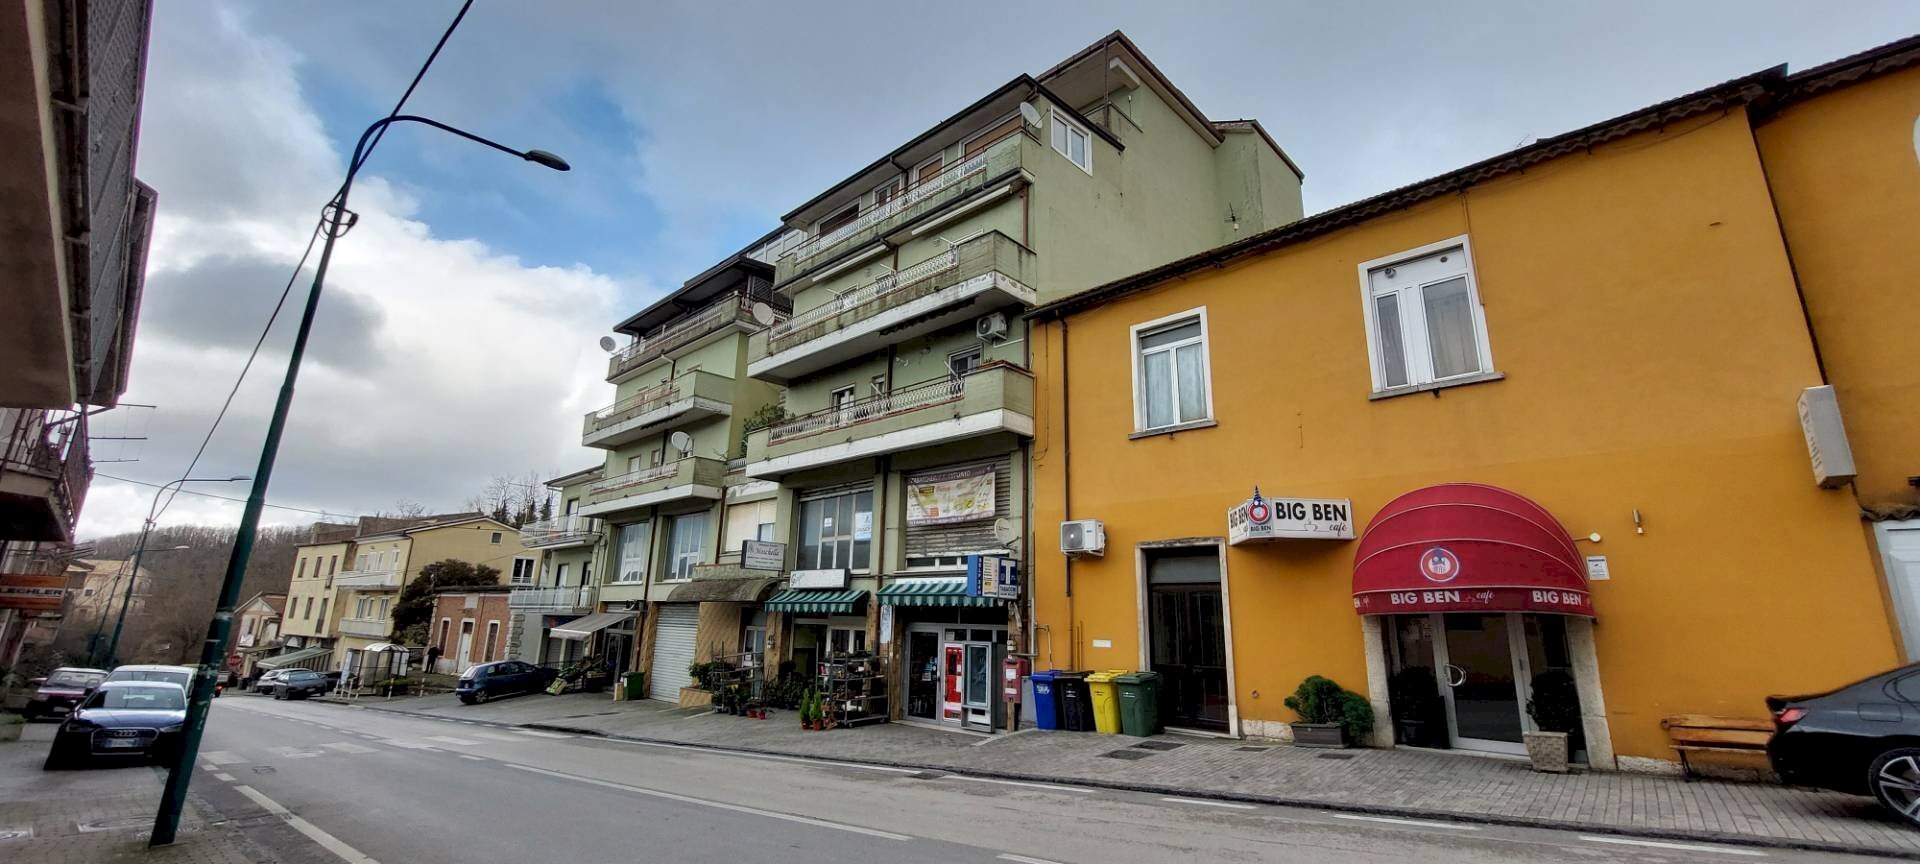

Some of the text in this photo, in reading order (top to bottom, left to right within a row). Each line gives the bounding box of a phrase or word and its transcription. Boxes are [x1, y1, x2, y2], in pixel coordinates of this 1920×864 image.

[1230, 509, 1238, 529] BIG
[1275, 502, 1348, 522] BIG BEN
[1001, 560, 1016, 585] T
[1390, 592, 1418, 605] BIG
[1423, 590, 1461, 604] BEN
[1532, 589, 1582, 606] BIG BEN
